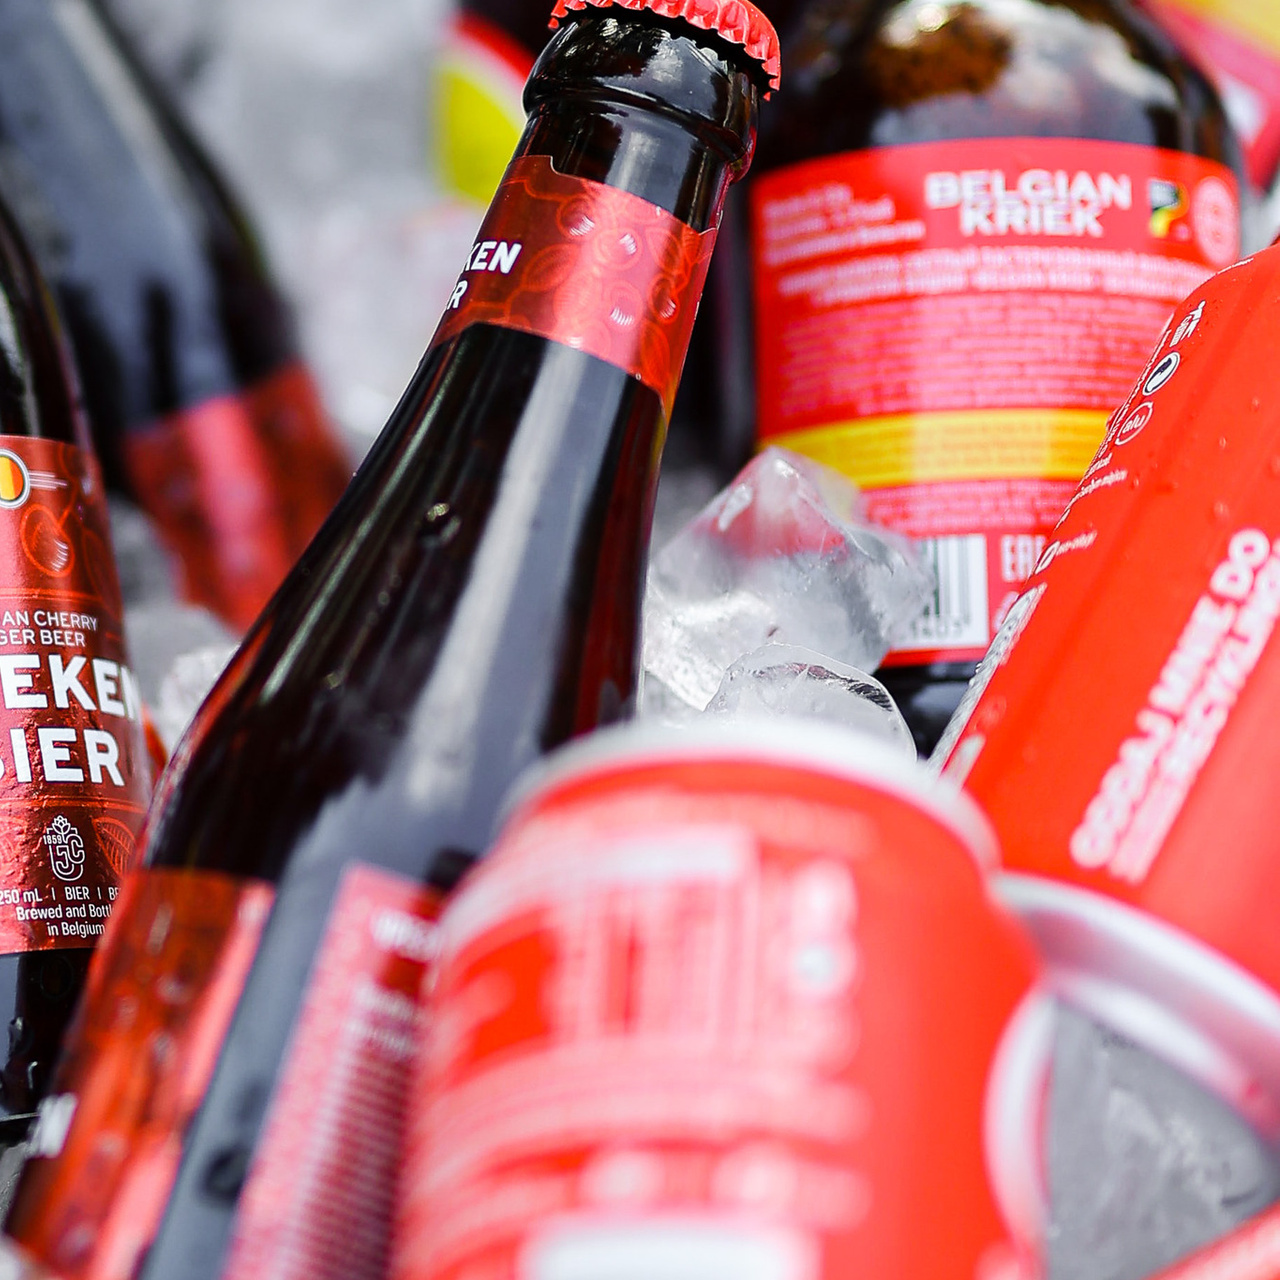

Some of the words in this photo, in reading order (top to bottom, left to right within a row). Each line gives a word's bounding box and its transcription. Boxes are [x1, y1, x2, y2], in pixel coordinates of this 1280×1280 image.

[925, 170, 1132, 209] BELGIAN
[959, 200, 1104, 237] KRIEK
[1122, 414, 1145, 435] alu
[33, 610, 97, 631] CHERRY
[40, 631, 85, 647] BEER
[43, 834, 62, 845] 1859
[23, 888, 43, 903] mL
[65, 886, 90, 901] BIER
[108, 886, 121, 900] BE
[16, 904, 62, 921] Brewed
[65, 904, 86, 918] and
[89, 904, 113, 918] Bottl
[46, 922, 58, 936] in
[61, 921, 106, 938] Belgium
